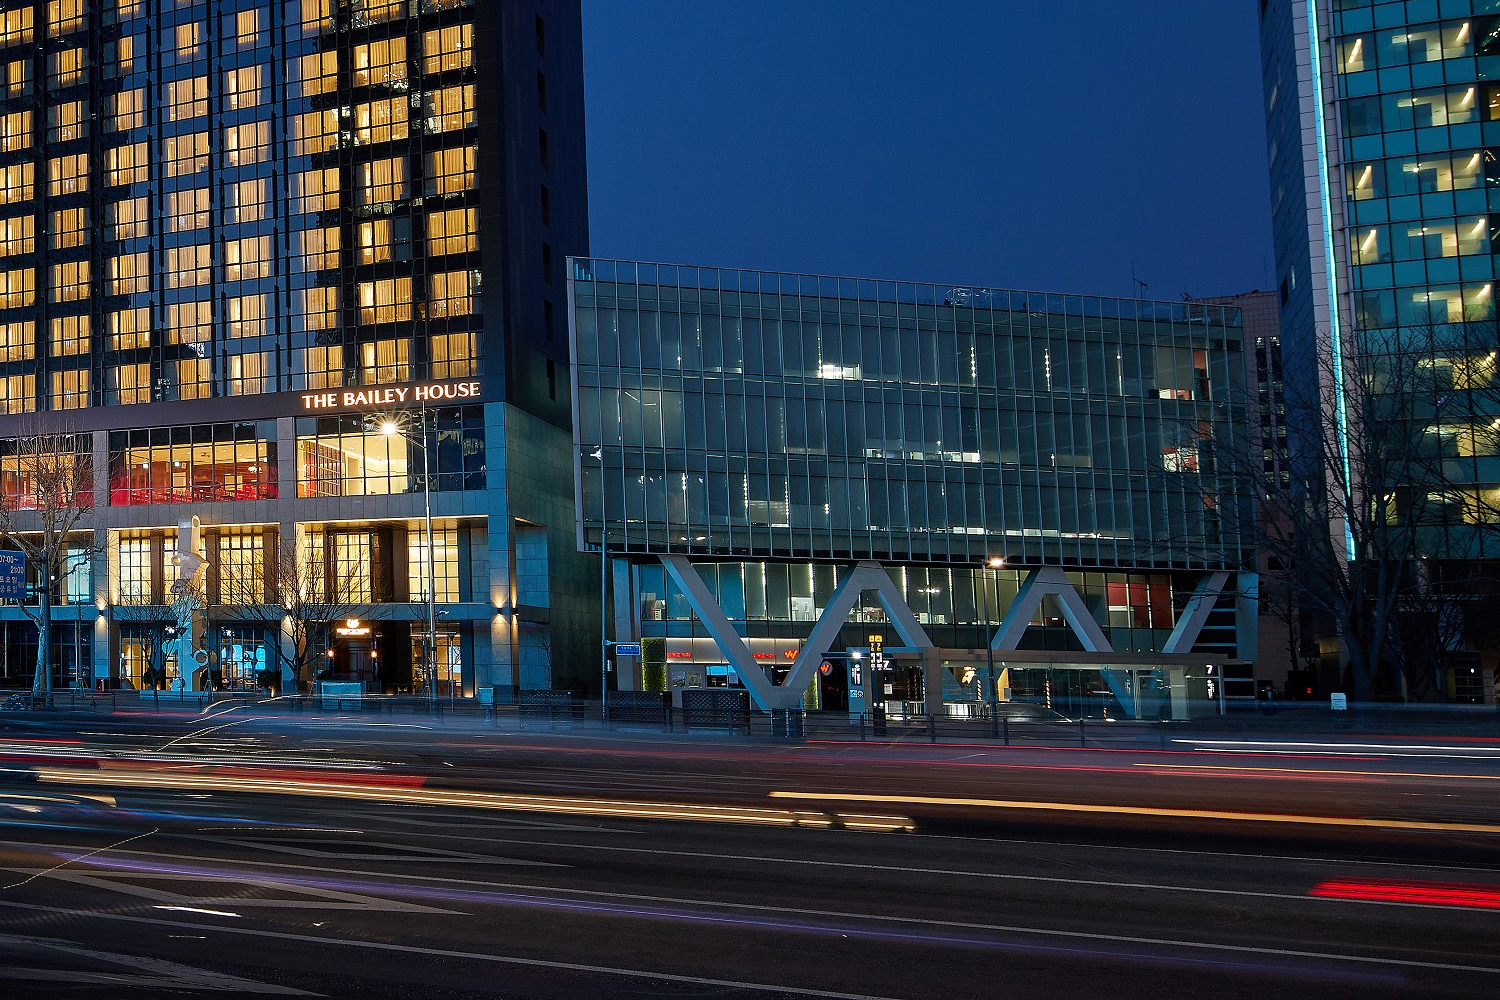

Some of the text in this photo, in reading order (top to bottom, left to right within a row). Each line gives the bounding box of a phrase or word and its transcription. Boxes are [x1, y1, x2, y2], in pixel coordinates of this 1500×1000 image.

[302, 382, 481, 409] THE BAILEY HOUSE
[1205, 664, 1214, 675] 7
